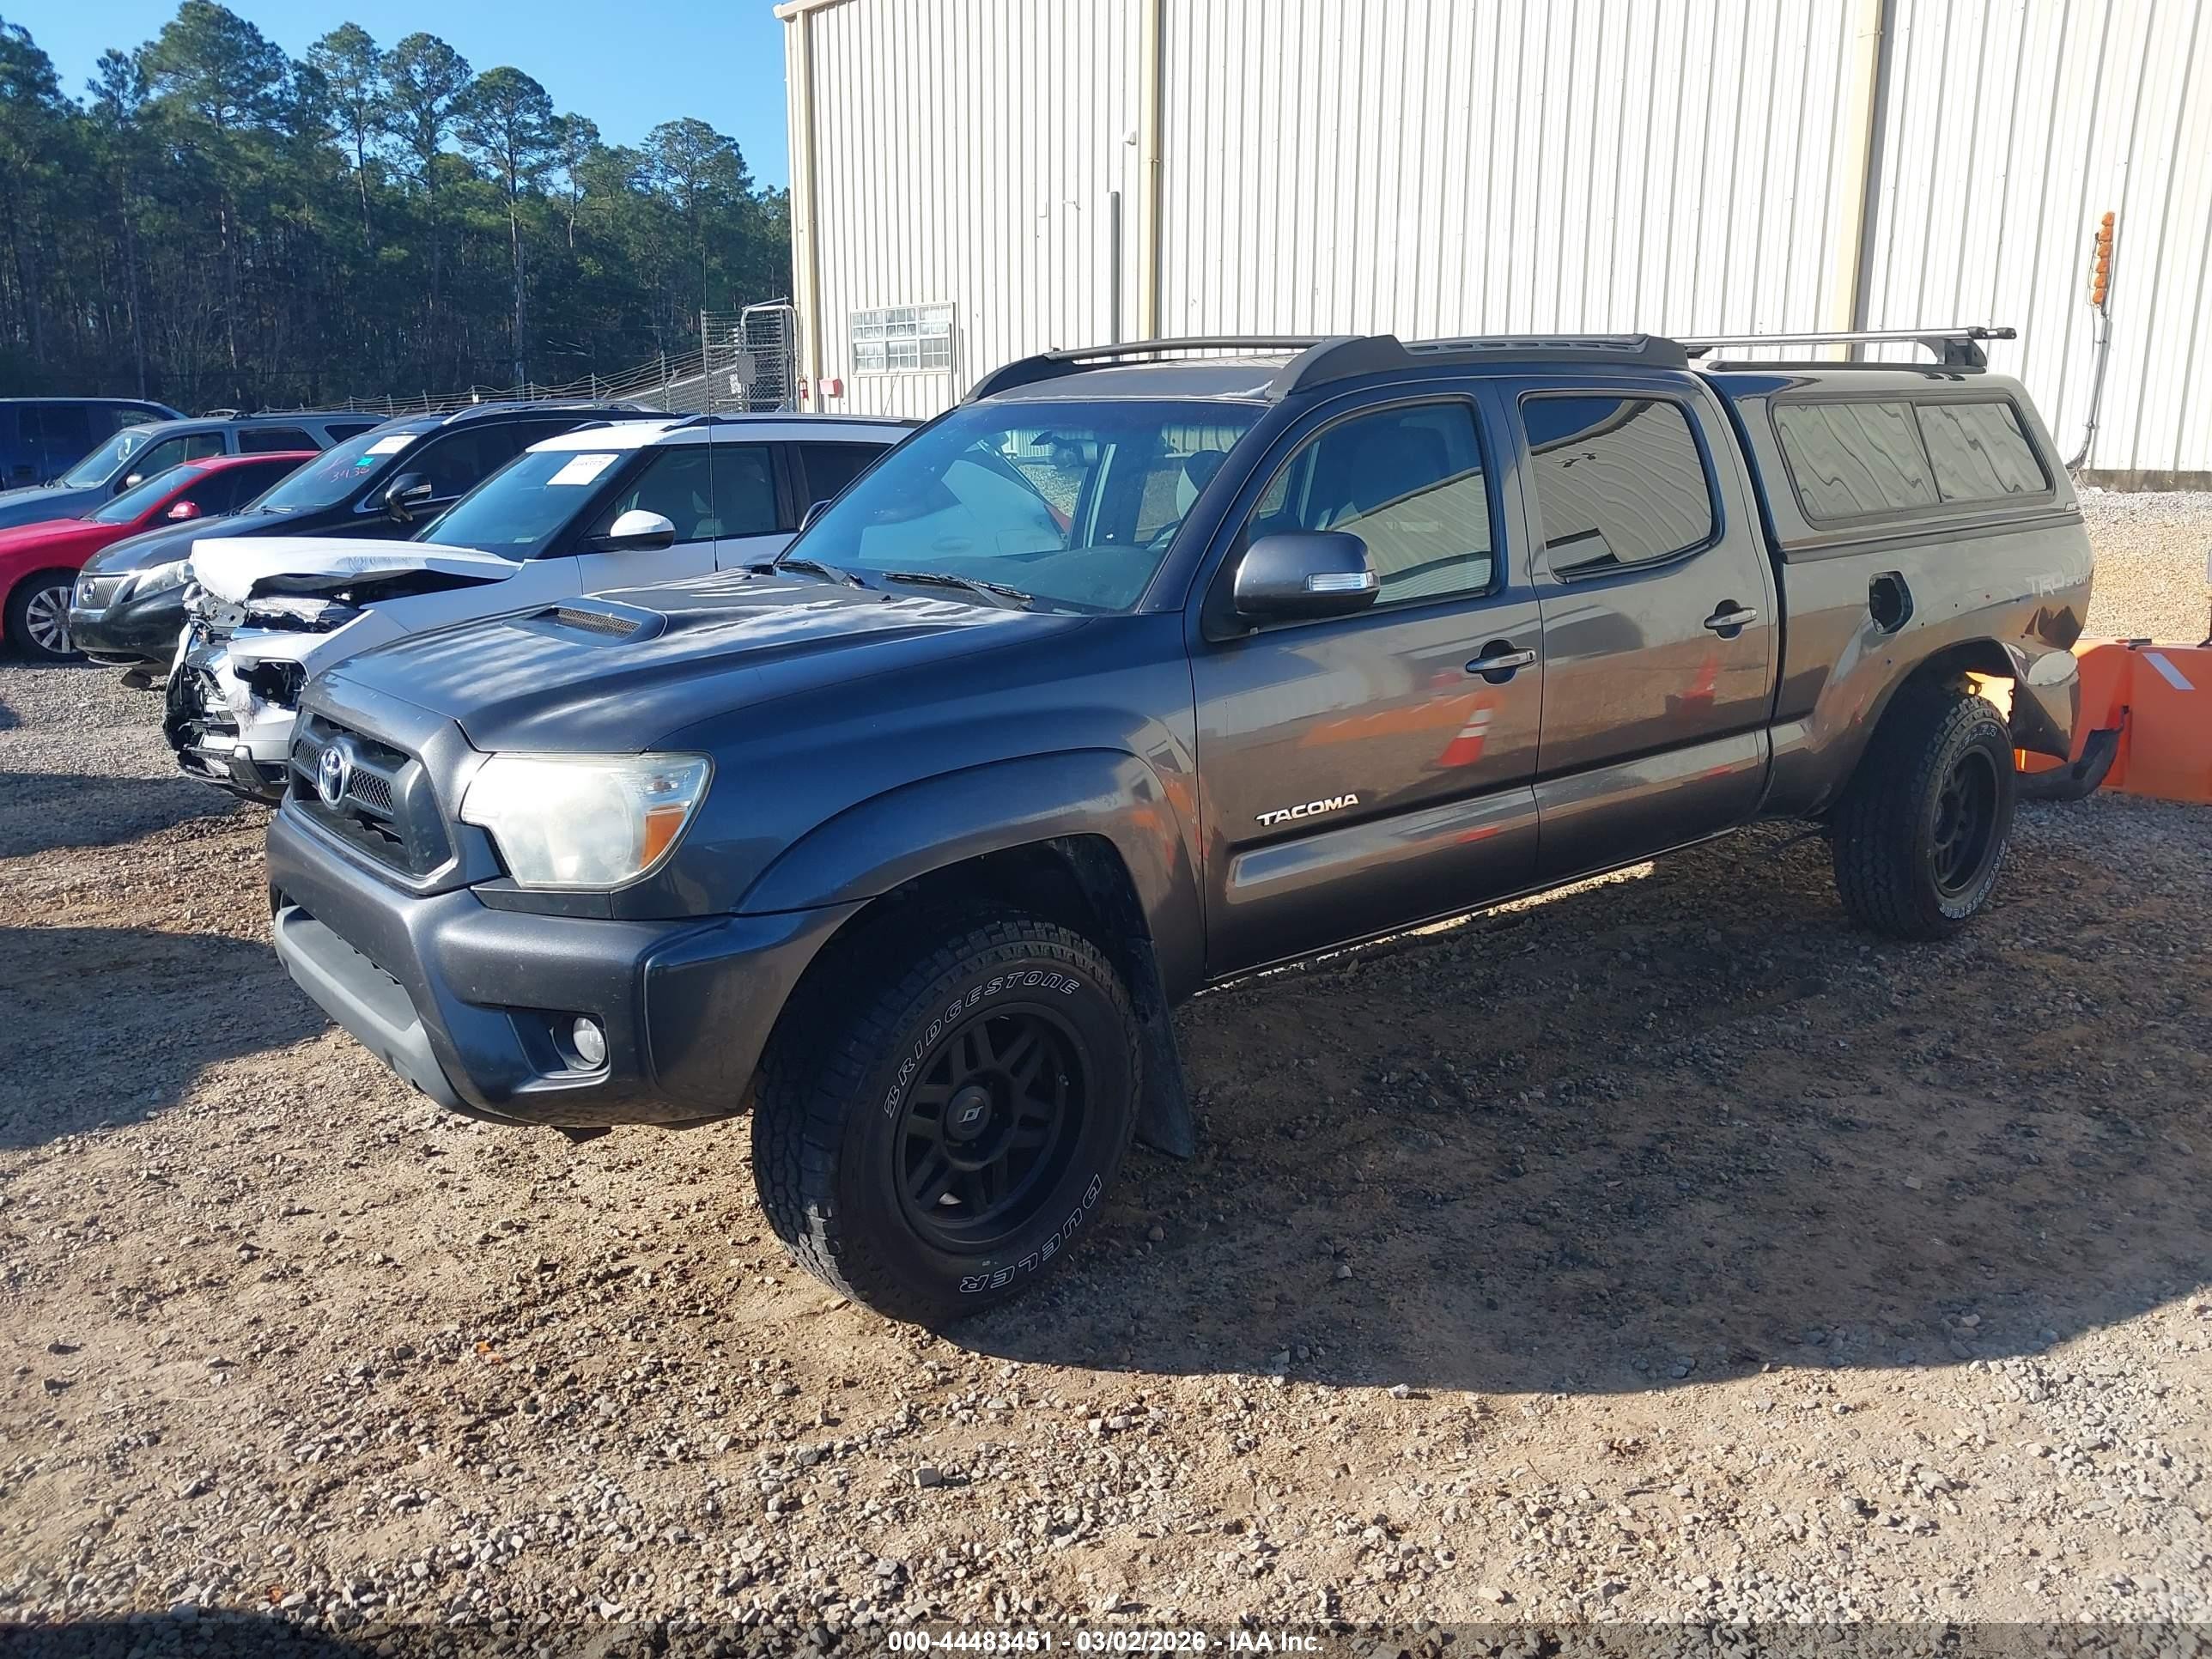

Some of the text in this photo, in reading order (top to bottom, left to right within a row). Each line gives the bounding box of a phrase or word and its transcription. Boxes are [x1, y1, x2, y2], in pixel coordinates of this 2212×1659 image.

[2025, 570, 2065, 598] TRD
[1255, 793, 1359, 826] TACOMA
[883, 969, 1081, 1119] BRIDGESTONE
[959, 1172, 1103, 1295] DUELER
